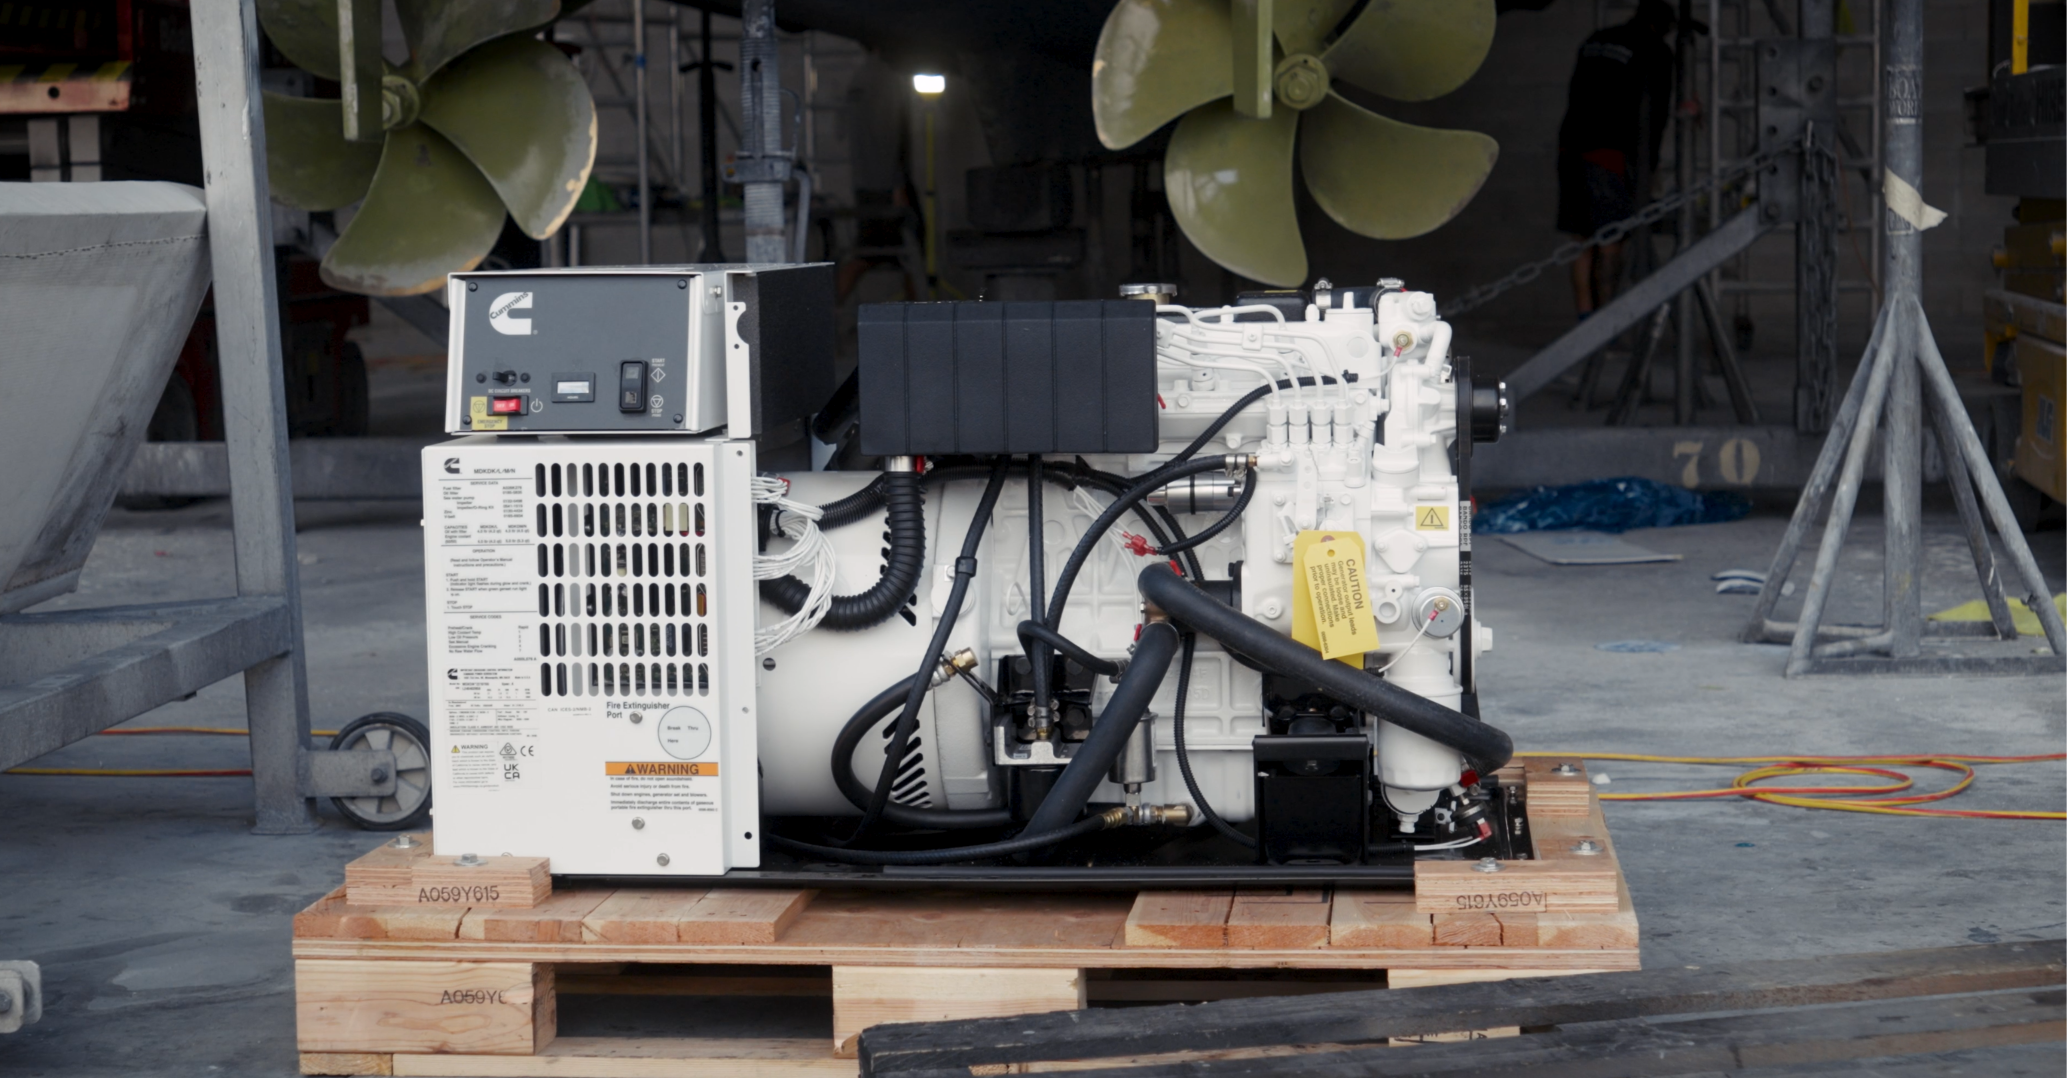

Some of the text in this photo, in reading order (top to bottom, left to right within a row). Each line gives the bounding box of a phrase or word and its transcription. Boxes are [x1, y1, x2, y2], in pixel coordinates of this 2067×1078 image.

[490, 292, 528, 319] Cummins
[1317, 564, 1326, 586] proper
[1322, 588, 1334, 628] connections
[1325, 563, 1336, 603] uninsulated.
[1338, 560, 1348, 593] Generator
[1345, 594, 1353, 615] output
[1346, 559, 1364, 610] CAUTION
[1316, 592, 1325, 625] operation.
[623, 702, 670, 710] Extinguisher
[638, 764, 698, 775] WARNING
[418, 885, 499, 902] A059Y615
[1456, 891, 1543, 910] A059Y615
